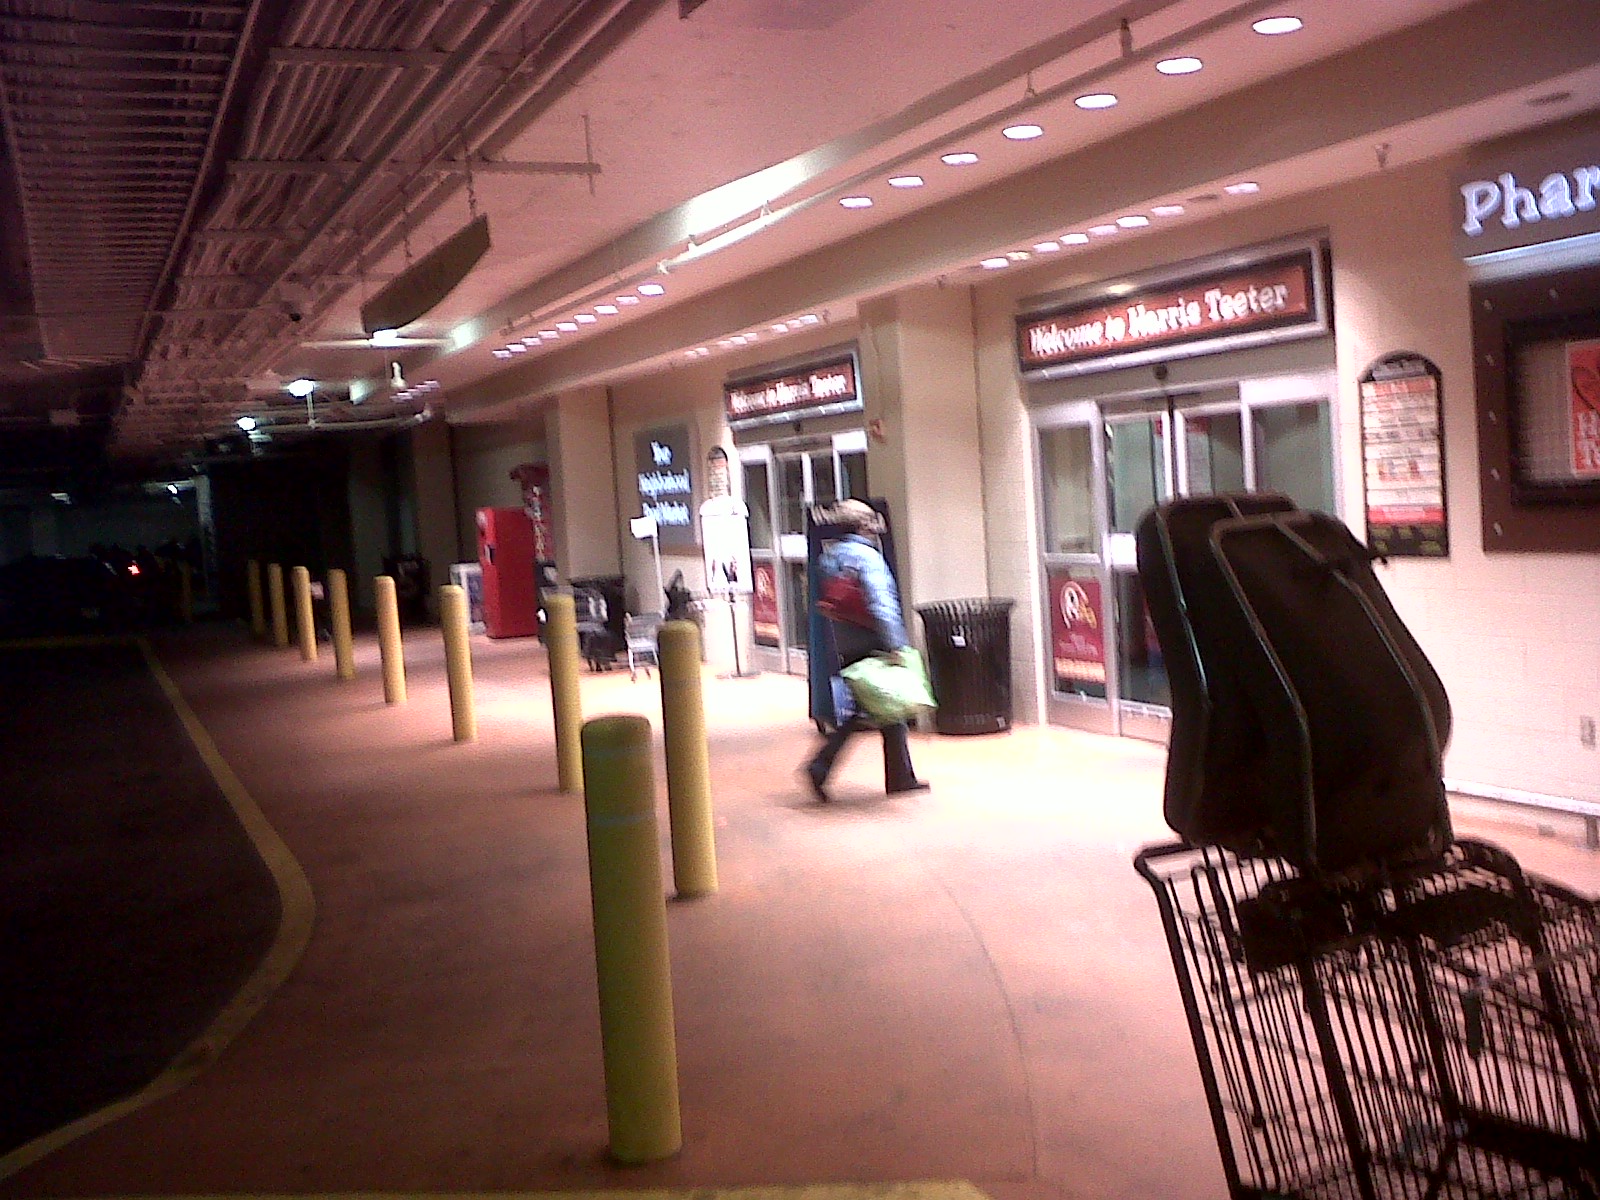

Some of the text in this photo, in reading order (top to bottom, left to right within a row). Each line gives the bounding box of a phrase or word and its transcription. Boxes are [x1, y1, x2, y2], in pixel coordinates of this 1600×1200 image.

[1028, 283, 1289, 356] Welcome to Harris Teeter
